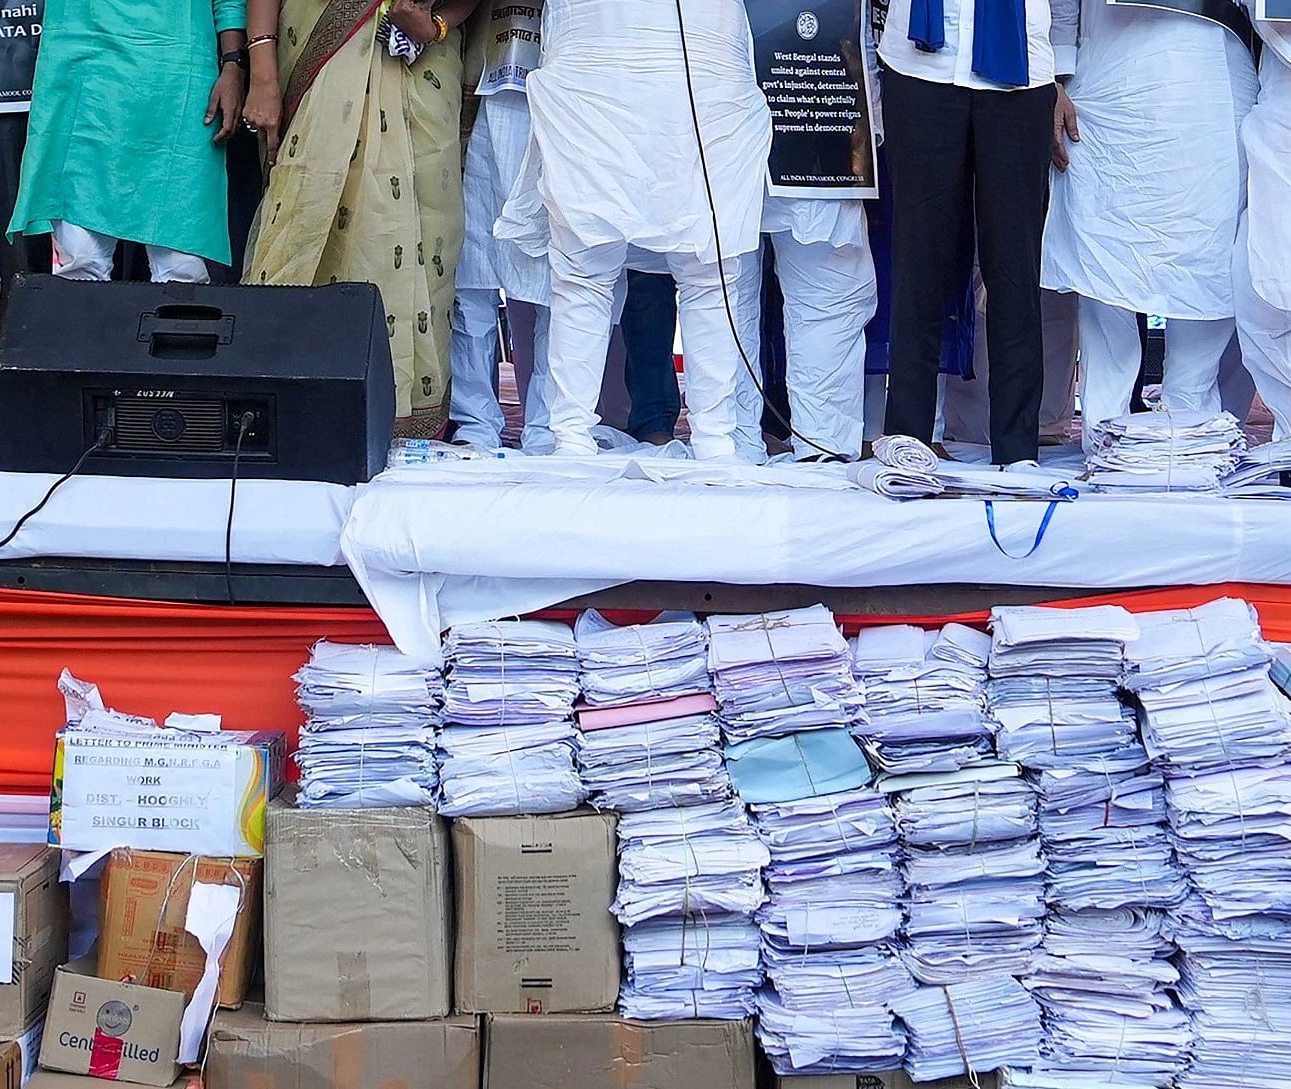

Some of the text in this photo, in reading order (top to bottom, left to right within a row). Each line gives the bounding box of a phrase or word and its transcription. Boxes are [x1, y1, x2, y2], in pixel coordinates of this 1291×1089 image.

[1, 4, 37, 18] nahi
[774, 52, 841, 63] West Bengal stands
[771, 66, 846, 77] united against central
[762, 80, 859, 91] govt's injustice, determined
[768, 95, 856, 106] to claim what's rightfully
[784, 109, 861, 120] People's power reigns
[774, 123, 856, 134] supreme in democracy.
[69, 738, 114, 747] LETTER
[117, 740, 132, 748] TO
[74, 755, 140, 765] REGARDING
[127, 775, 161, 785] WORK
[137, 794, 208, 807] HOOGHLY
[92, 816, 199, 829] SINGUR BLOCK
